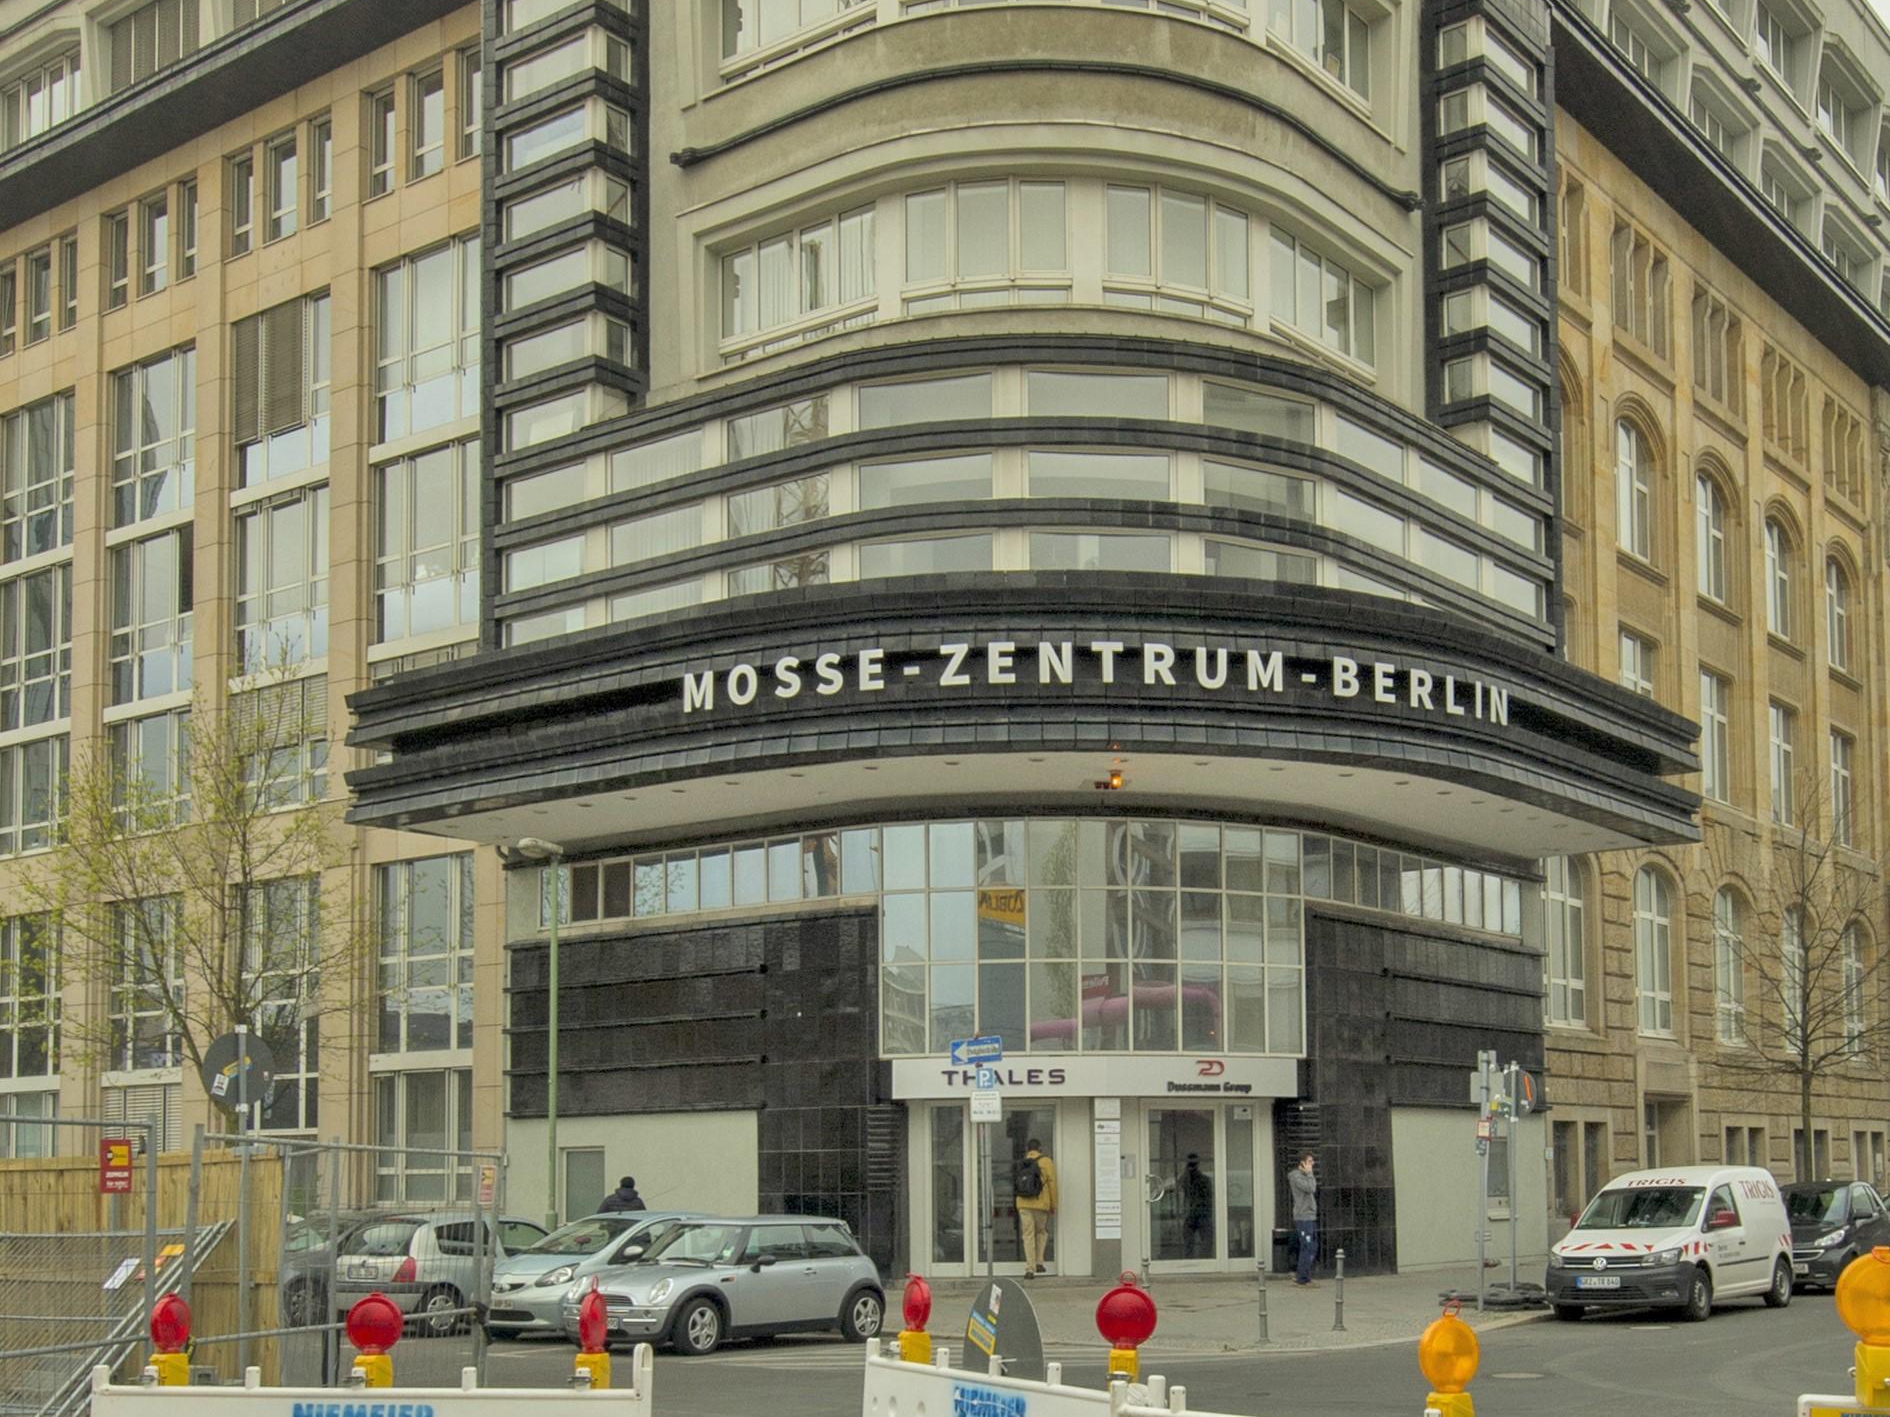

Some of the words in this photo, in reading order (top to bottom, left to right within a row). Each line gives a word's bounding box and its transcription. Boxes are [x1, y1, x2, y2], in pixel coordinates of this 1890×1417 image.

[682, 641, 1510, 726] MOSSE-ZENTRUM-BERLIN
[941, 1069, 1066, 1086] THALES
[1167, 1081, 1221, 1093] Dussmann
[1223, 1081, 1252, 1094] Group
[1627, 1178, 1687, 1187] TRIGIS
[1737, 1180, 1775, 1199] TRIGIS
